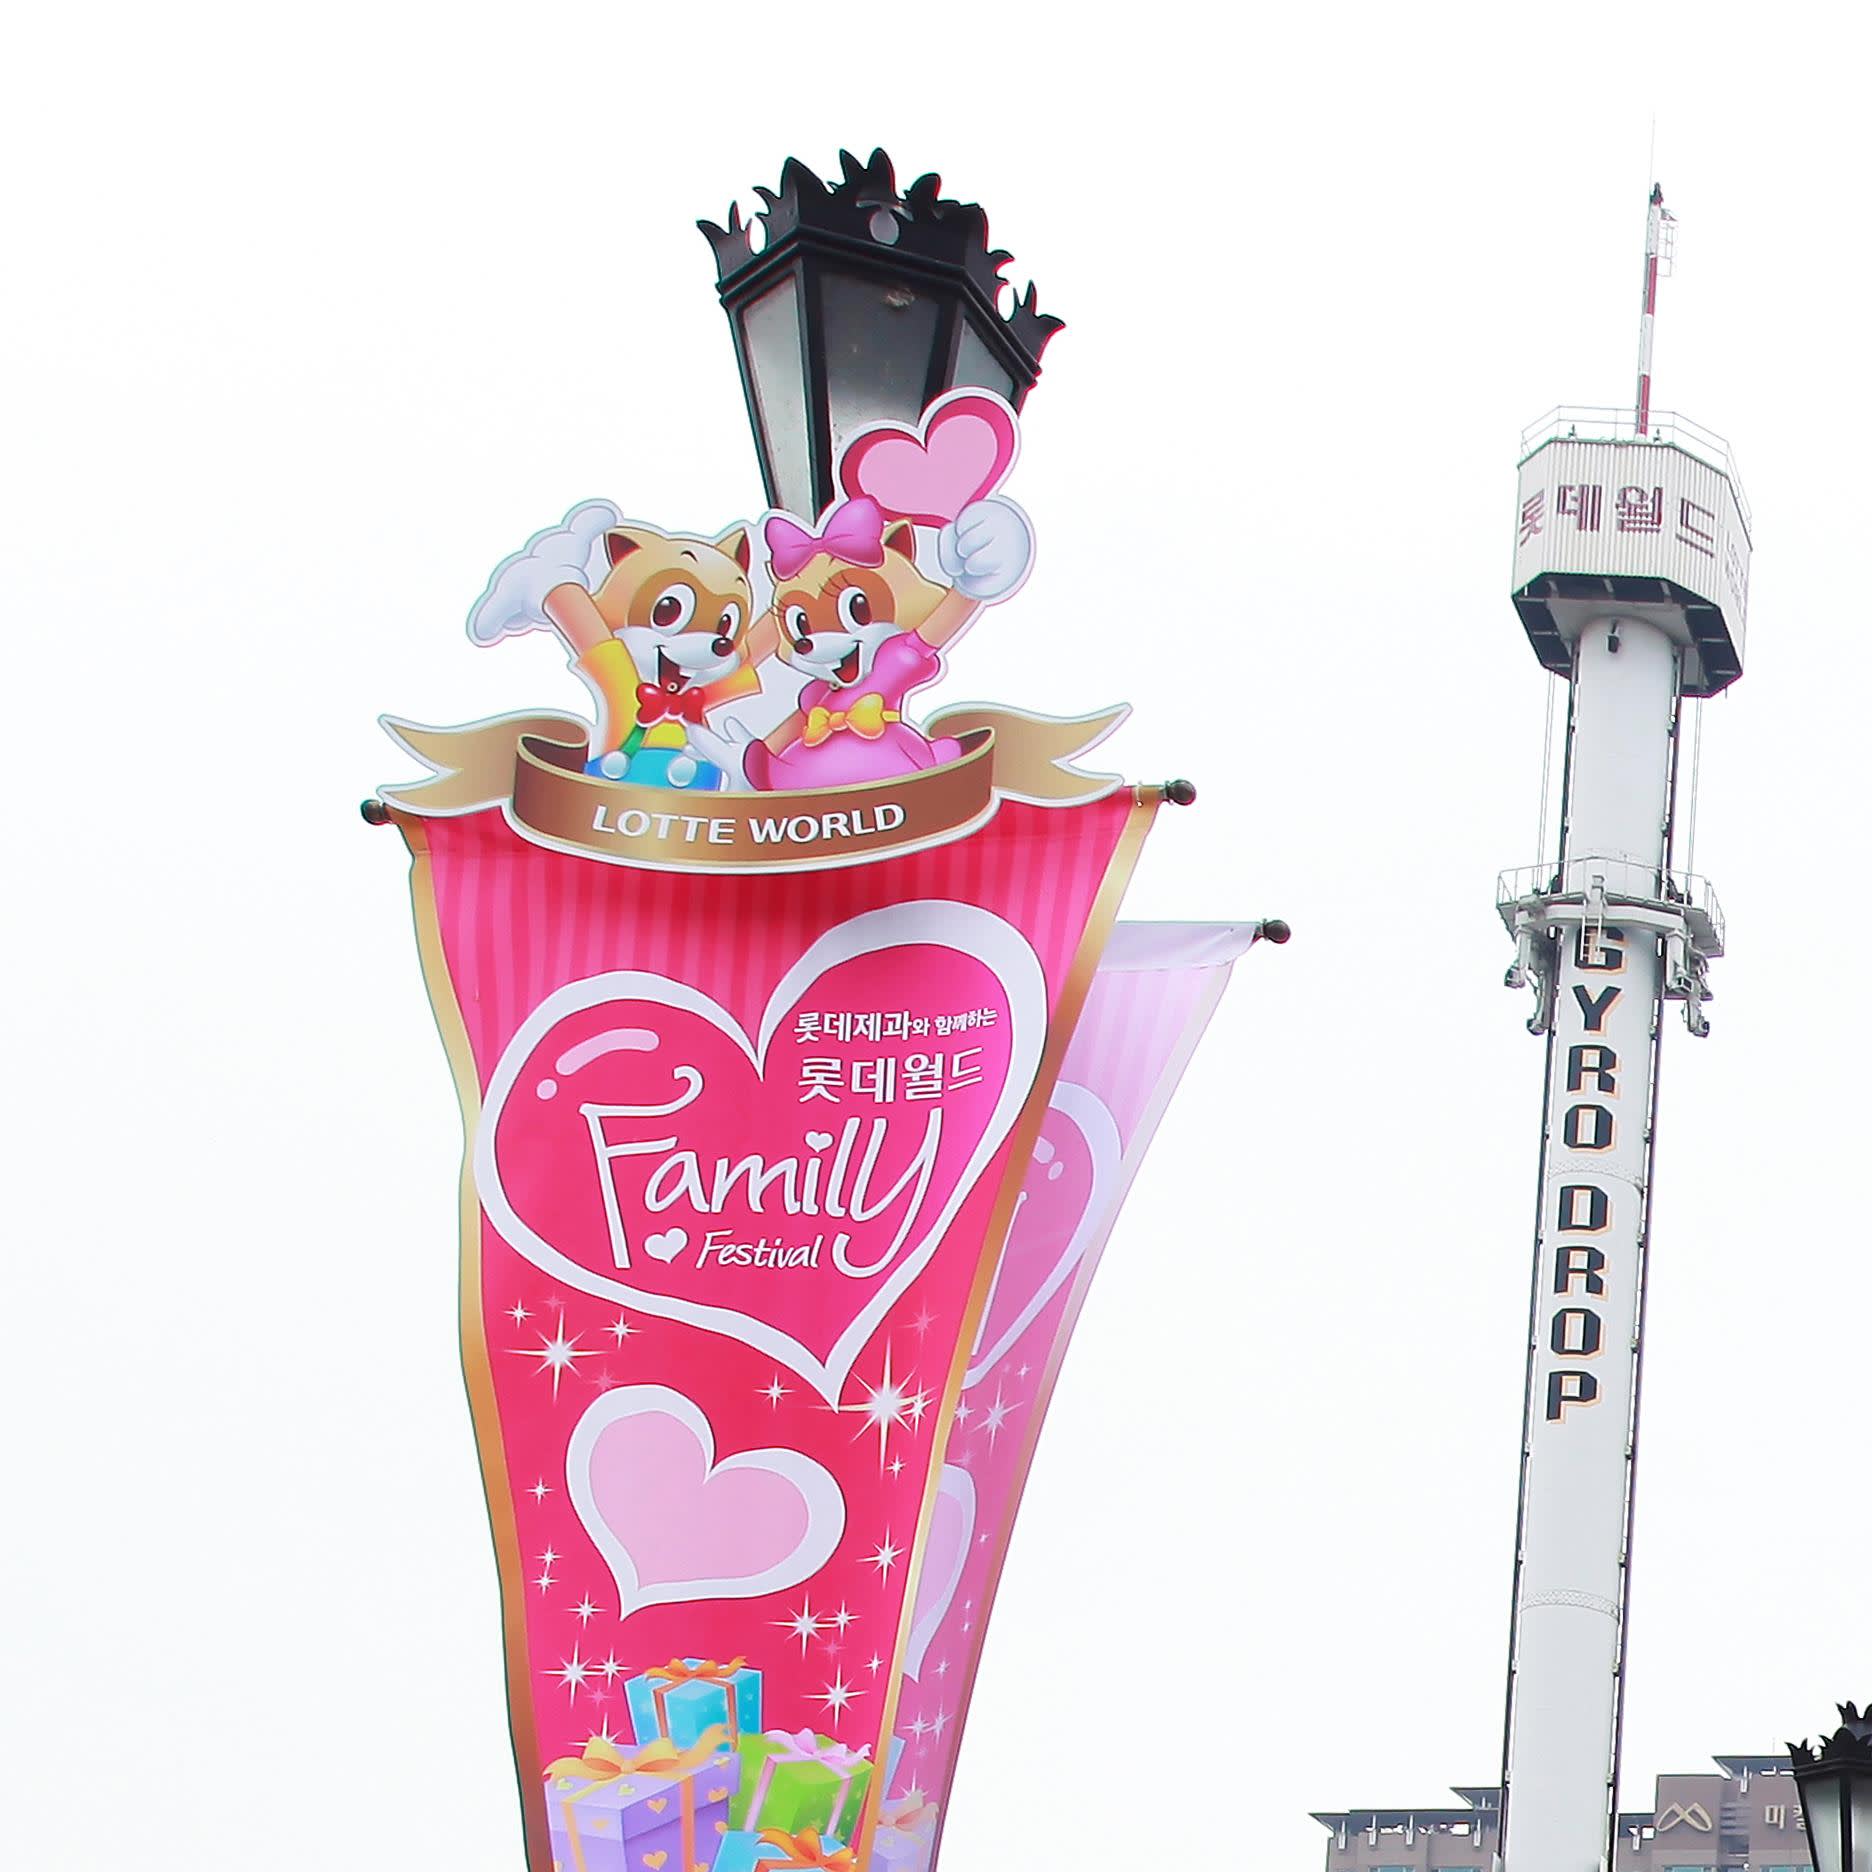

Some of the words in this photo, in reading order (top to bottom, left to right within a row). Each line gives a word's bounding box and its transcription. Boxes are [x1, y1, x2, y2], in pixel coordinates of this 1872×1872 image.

[1519, 484, 1715, 559] 롯데월드
[591, 804, 737, 844] LOTTE
[748, 803, 906, 844] WORLD
[793, 1010, 931, 1044] 롯데제과와
[1563, 925, 1628, 1154] GYRO
[798, 1047, 984, 1103] 롯데월드
[578, 1065, 944, 1278] Family
[696, 1229, 824, 1268] Festival
[1546, 1184, 1613, 1425] DROP
